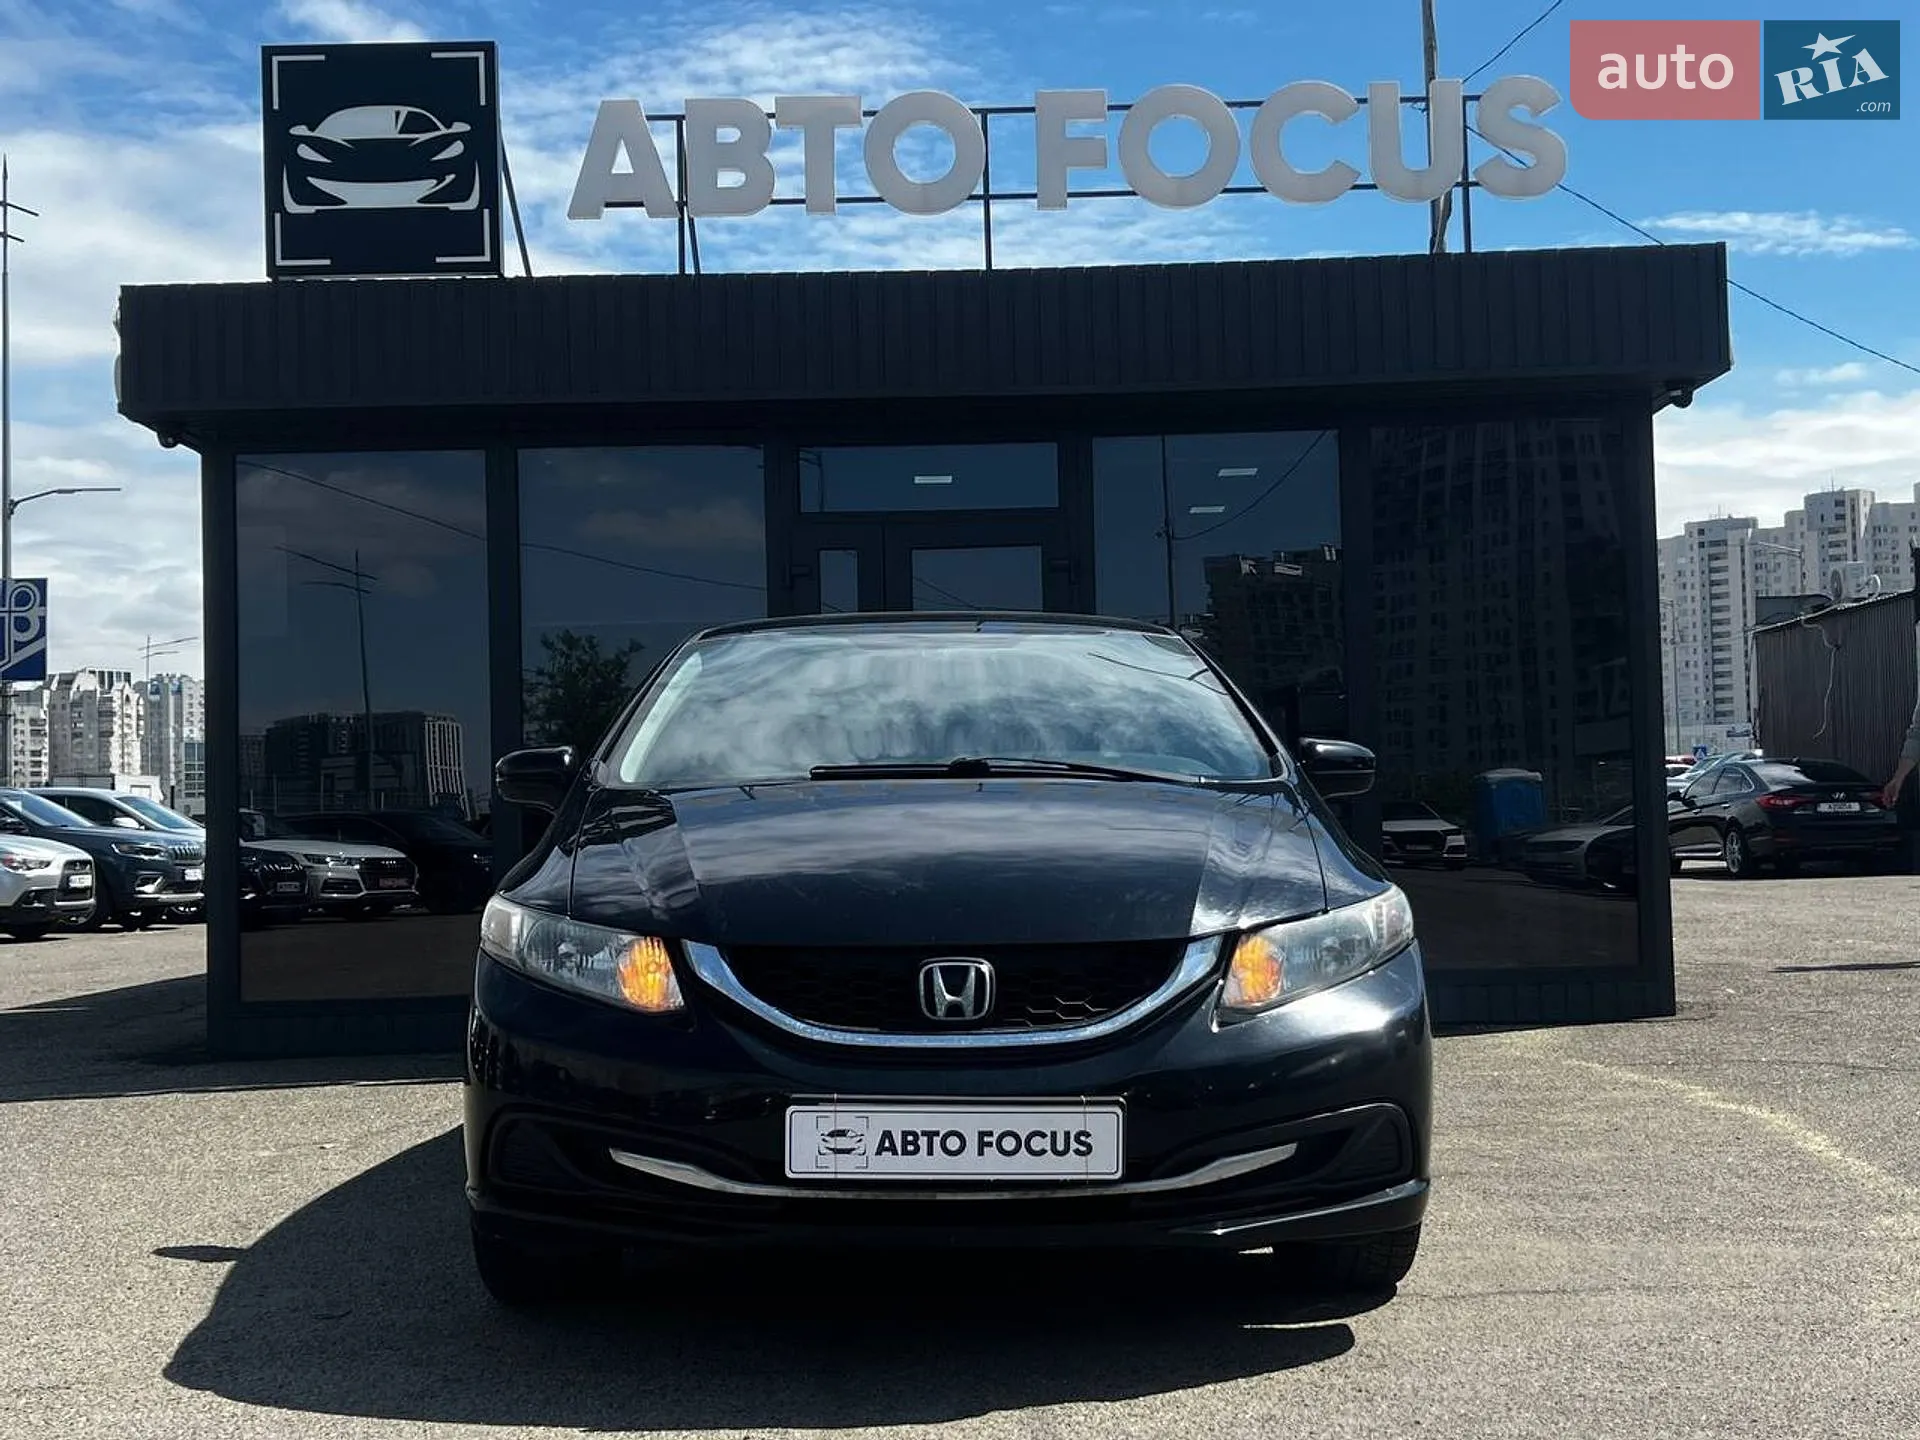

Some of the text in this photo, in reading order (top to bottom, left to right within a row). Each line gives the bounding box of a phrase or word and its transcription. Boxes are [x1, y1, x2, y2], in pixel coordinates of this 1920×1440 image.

[567, 74, 1567, 220] АВТО FOCUS
[874, 1130, 1093, 1157] АВТО FOCUS
